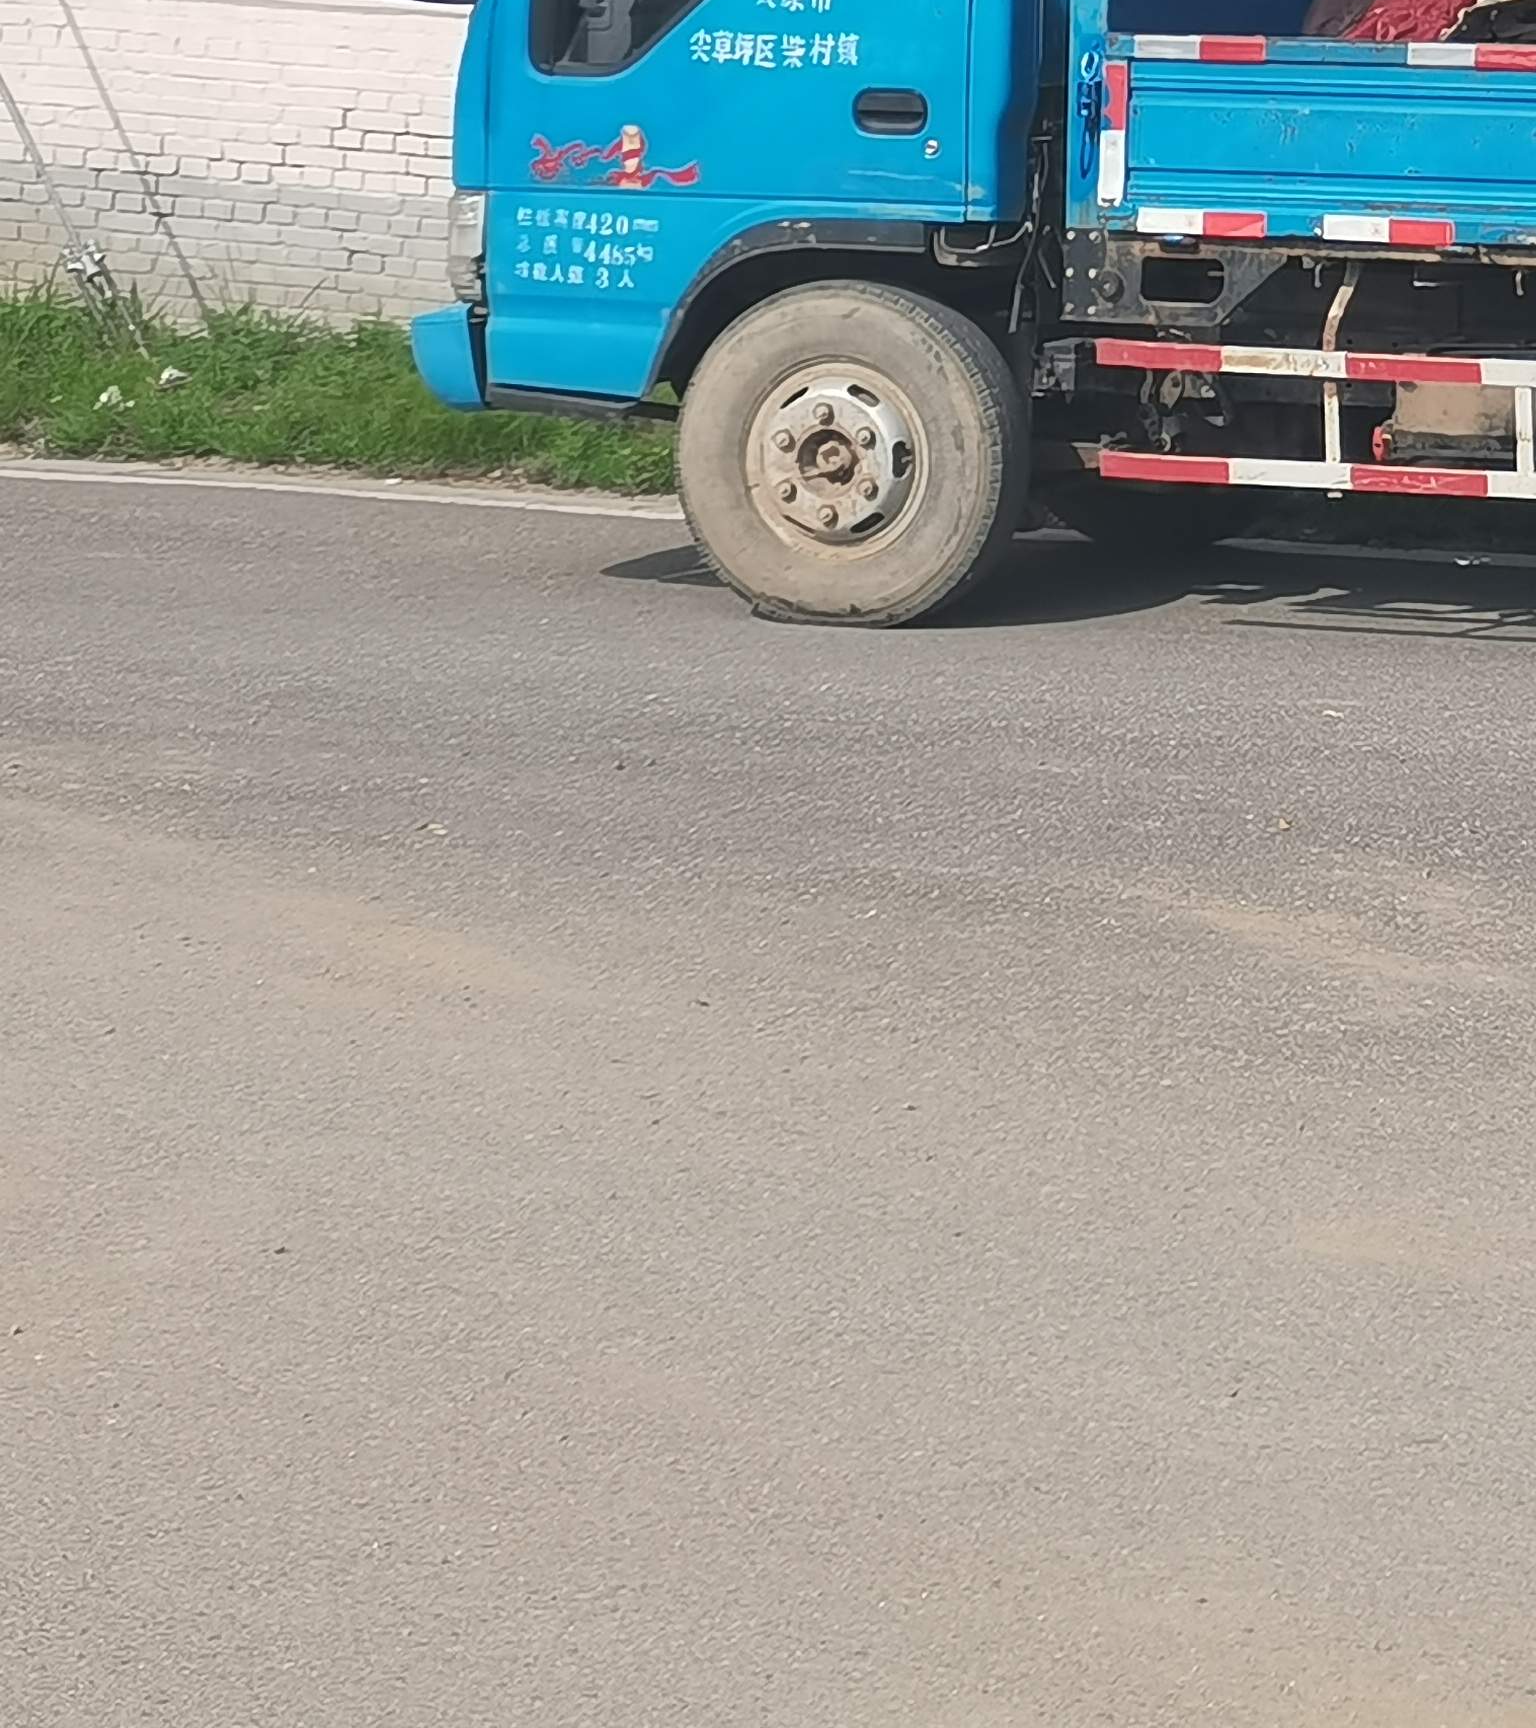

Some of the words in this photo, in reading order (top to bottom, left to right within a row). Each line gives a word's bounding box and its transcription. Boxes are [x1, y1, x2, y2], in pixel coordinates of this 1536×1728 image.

[689, 28, 860, 69] 尖草坪区柴村镇
